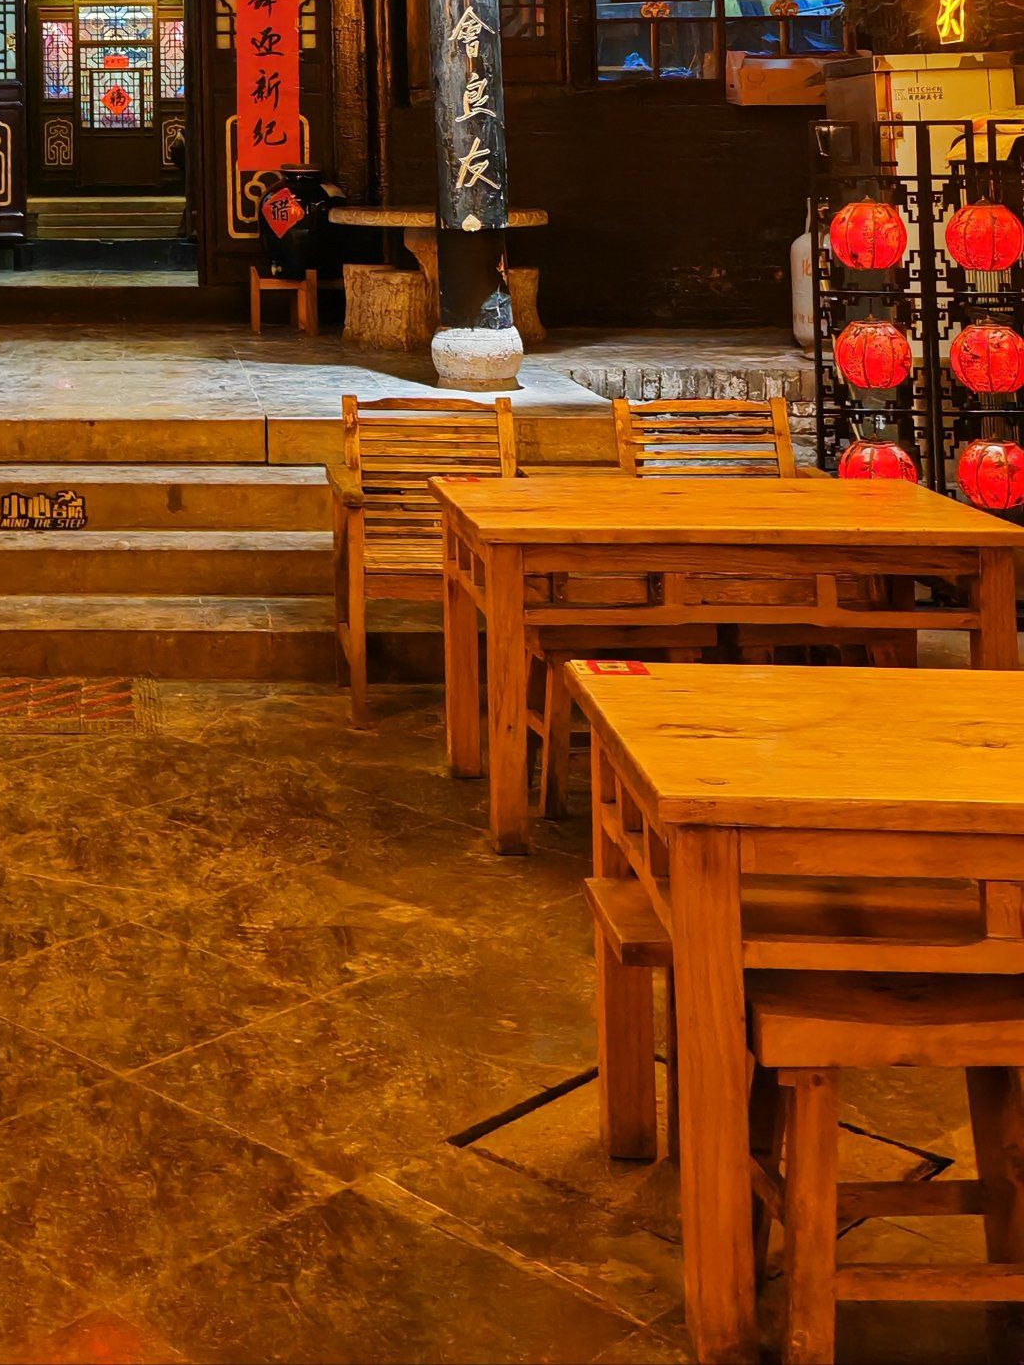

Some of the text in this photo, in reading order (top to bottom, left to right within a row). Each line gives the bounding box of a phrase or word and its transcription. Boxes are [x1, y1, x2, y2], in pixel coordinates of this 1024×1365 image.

[0, 518, 86, 528] MIND THE STEP
